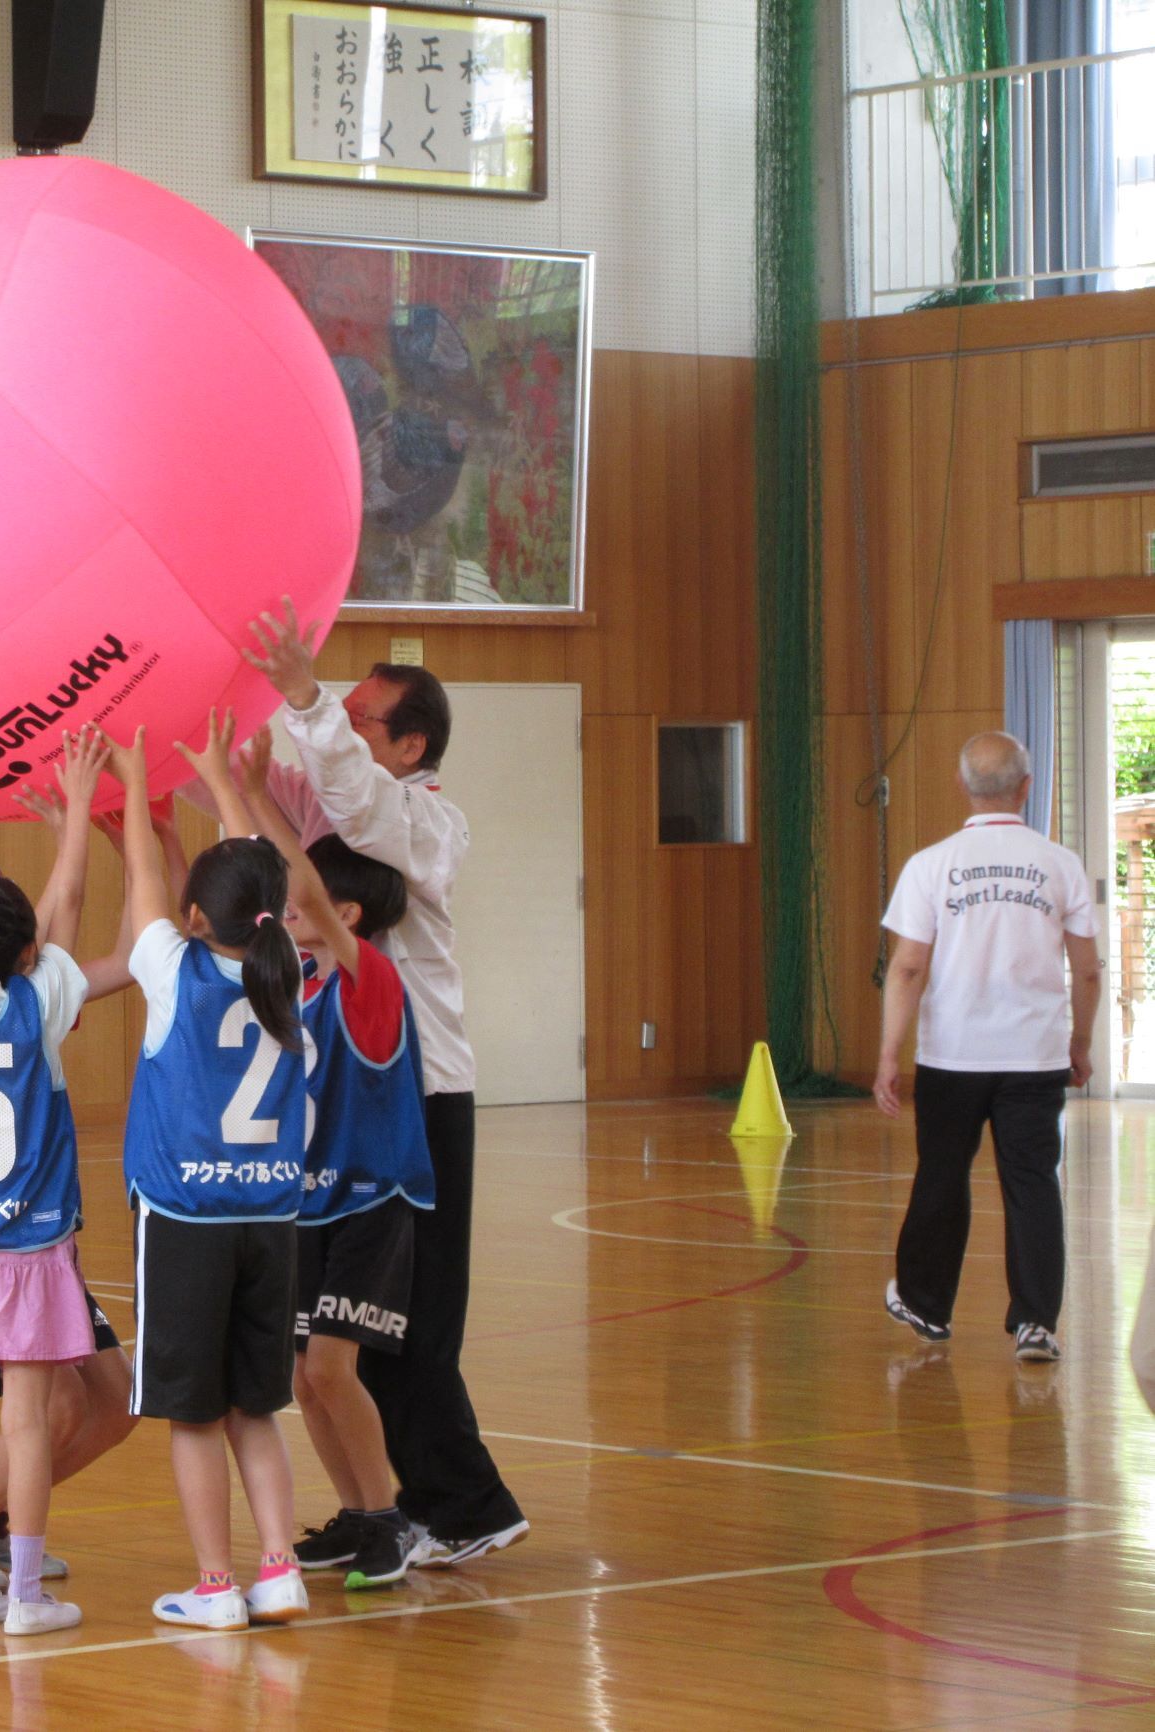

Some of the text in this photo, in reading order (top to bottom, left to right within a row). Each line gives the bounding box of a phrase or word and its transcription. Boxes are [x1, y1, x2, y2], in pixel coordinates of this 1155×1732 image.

[335, 25, 358, 160] おおらかに
[416, 36, 445, 163] 正しく
[110, 652, 161, 705] Distributor
[948, 864, 1049, 888] Community
[218, 996, 282, 1144] 2
[180, 1161, 300, 1183] アクティブあぐい
